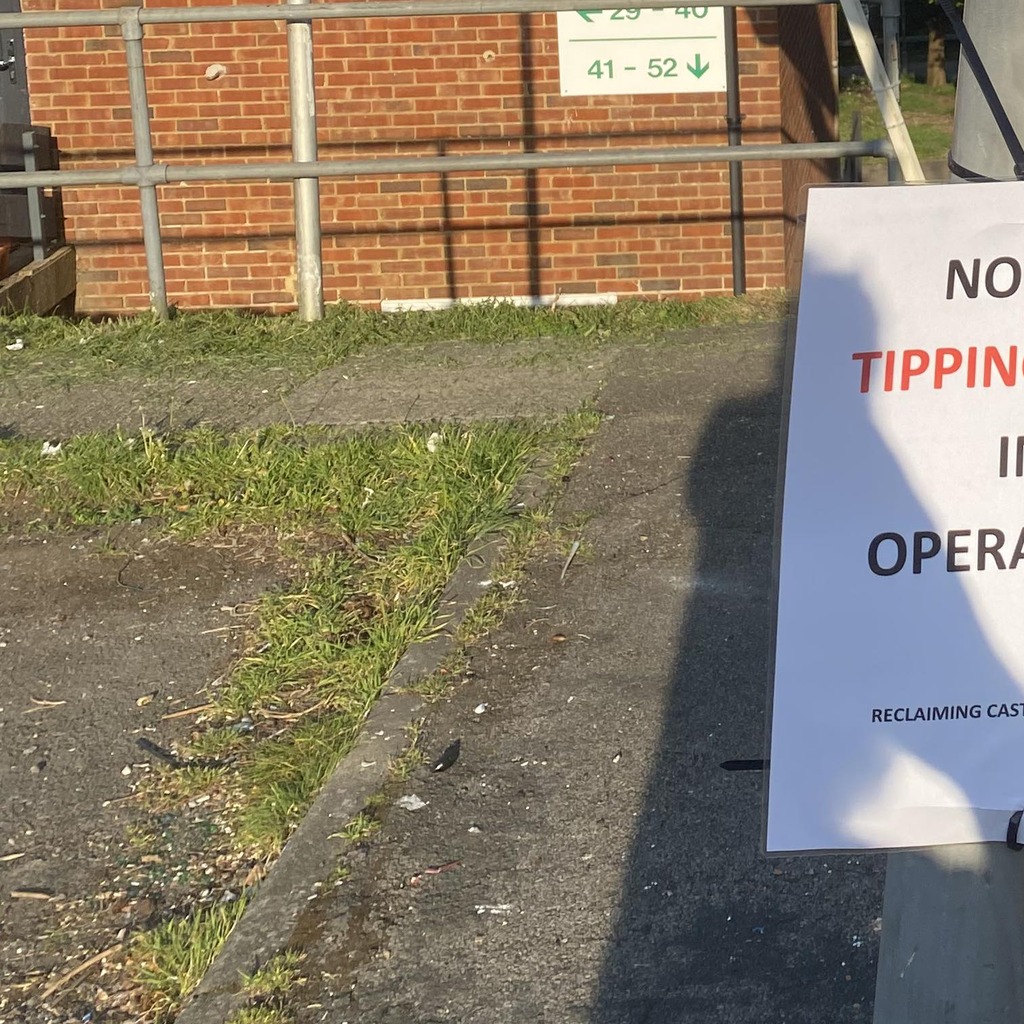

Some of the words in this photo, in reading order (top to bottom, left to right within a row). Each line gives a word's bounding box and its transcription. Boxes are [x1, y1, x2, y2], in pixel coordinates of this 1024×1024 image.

[587, 59, 614, 79] 41
[647, 58, 678, 79] 52
[946, 256, 1022, 300] NO
[871, 704, 982, 724] RECLAIMING
